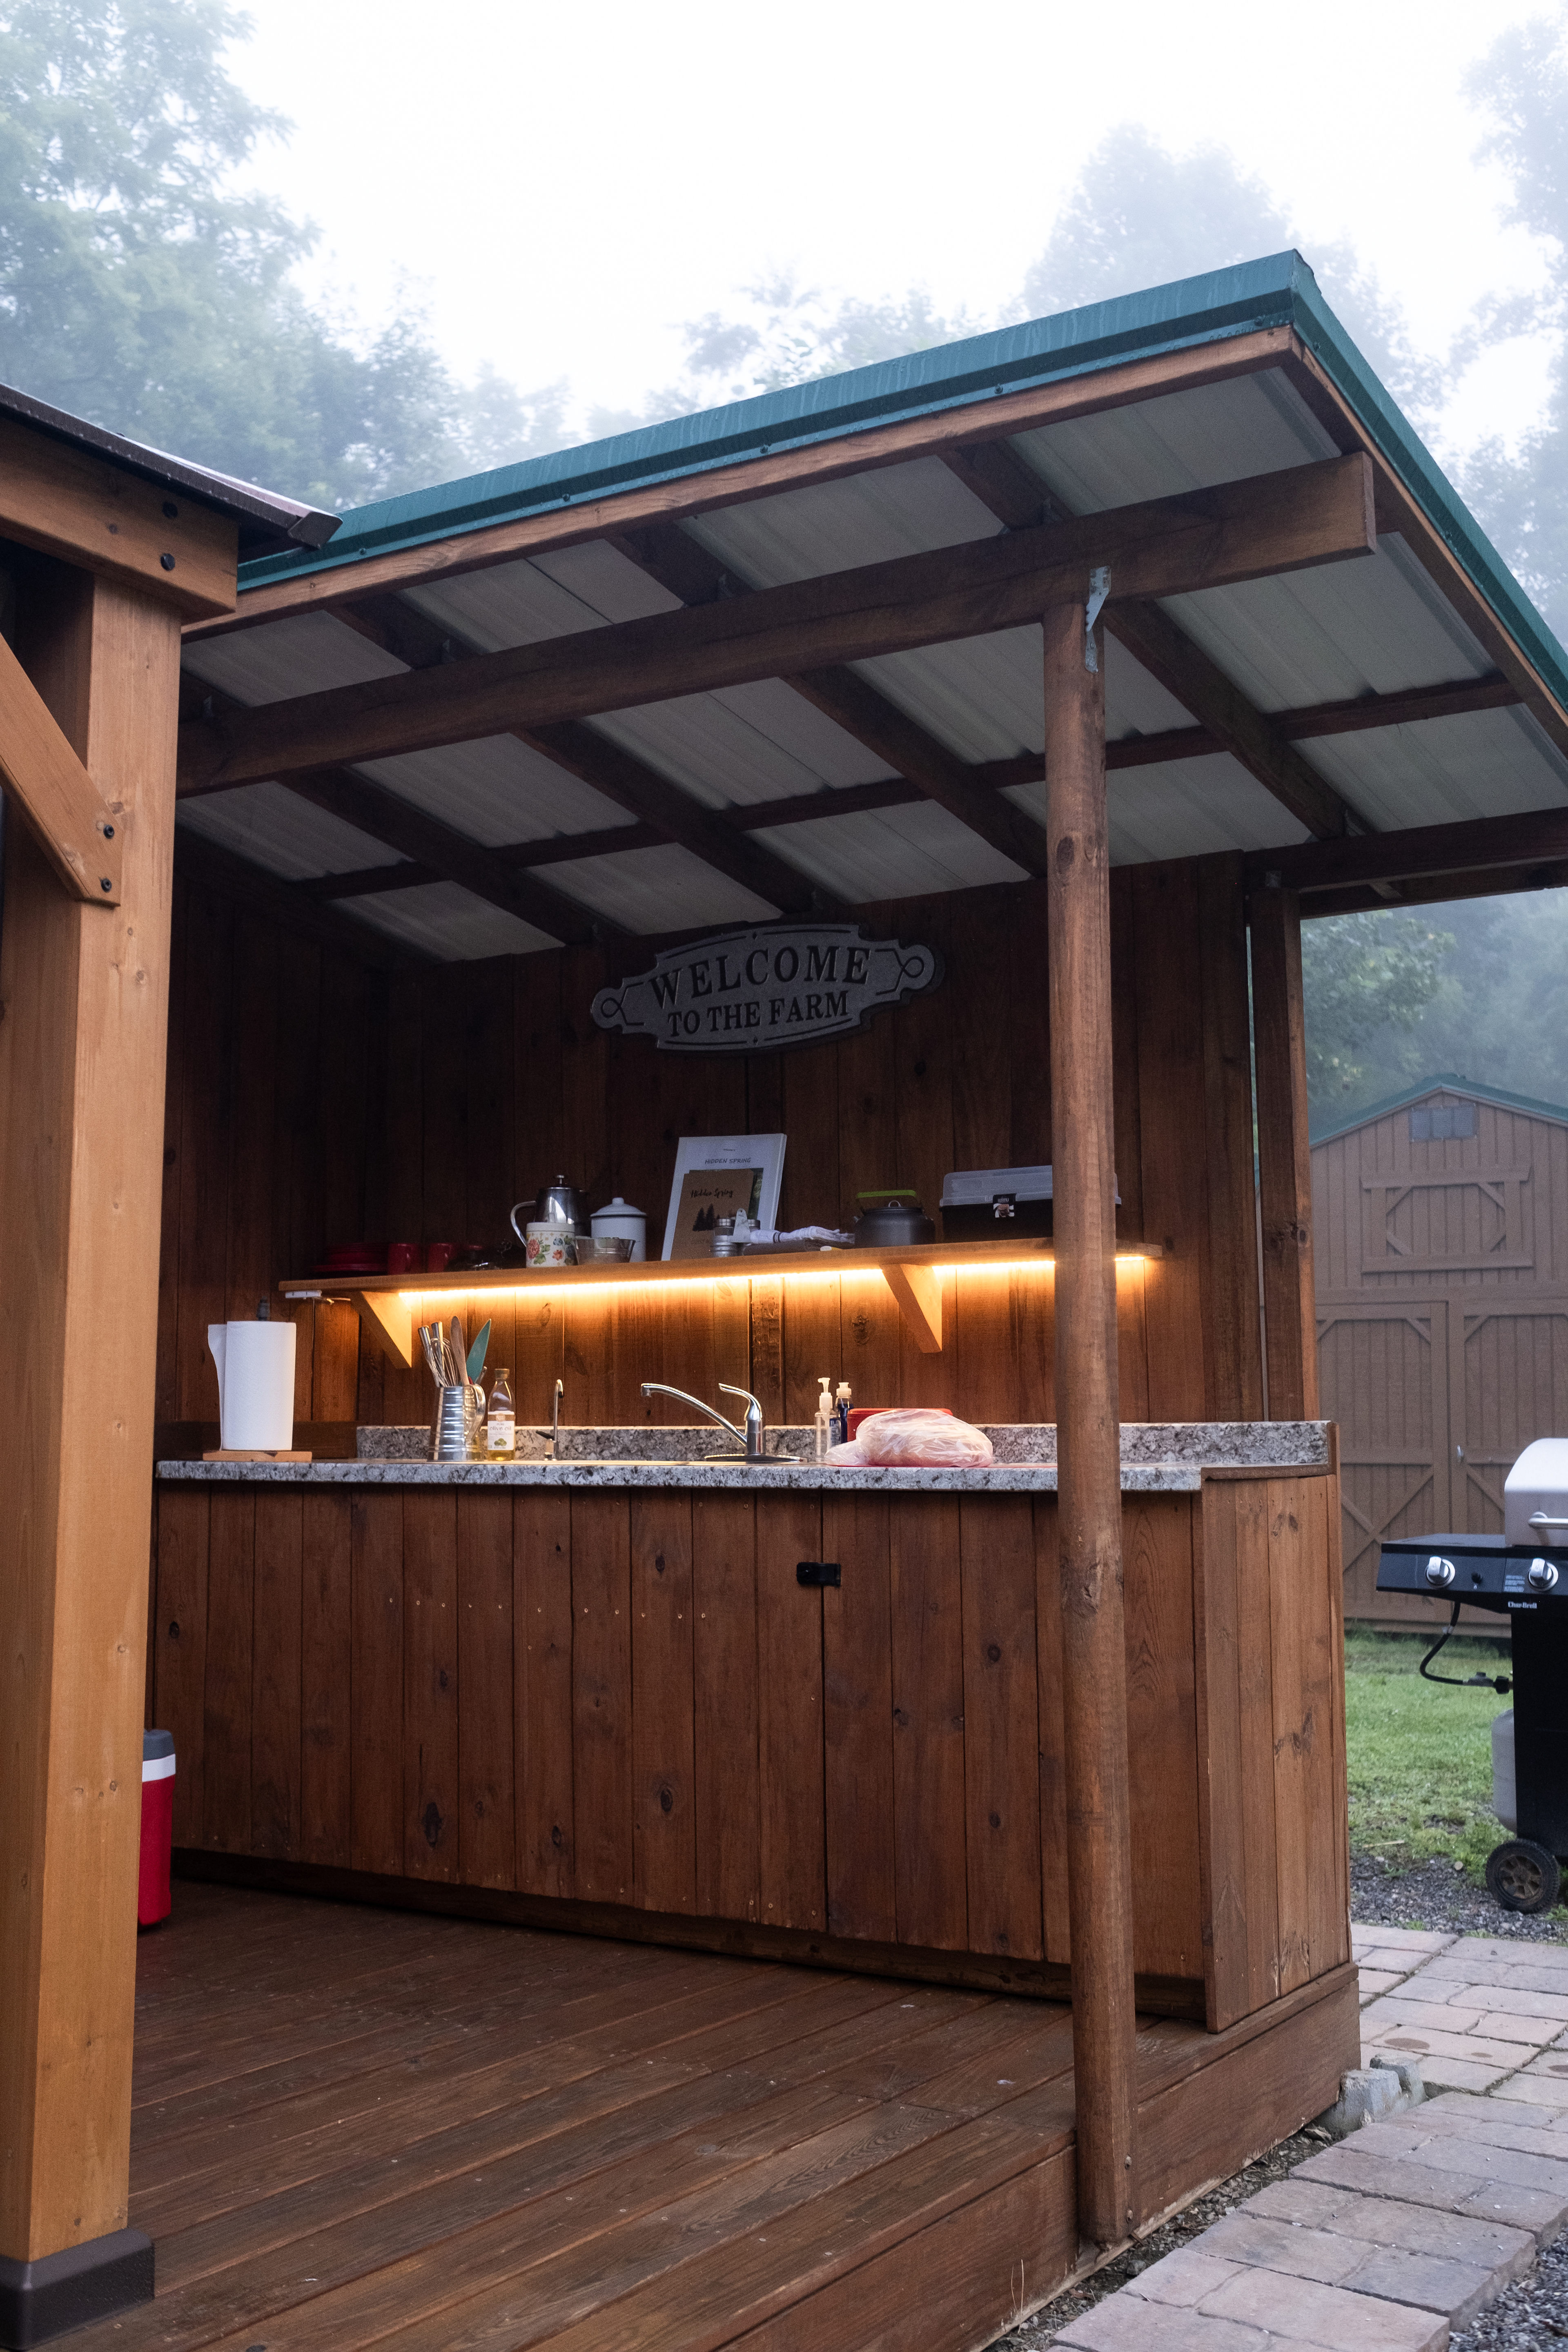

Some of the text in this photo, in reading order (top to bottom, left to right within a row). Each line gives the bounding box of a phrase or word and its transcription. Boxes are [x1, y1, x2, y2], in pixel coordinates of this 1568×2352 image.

[648, 945, 871, 1009] WELCOME
[668, 990, 849, 1037] TO THE FARM
